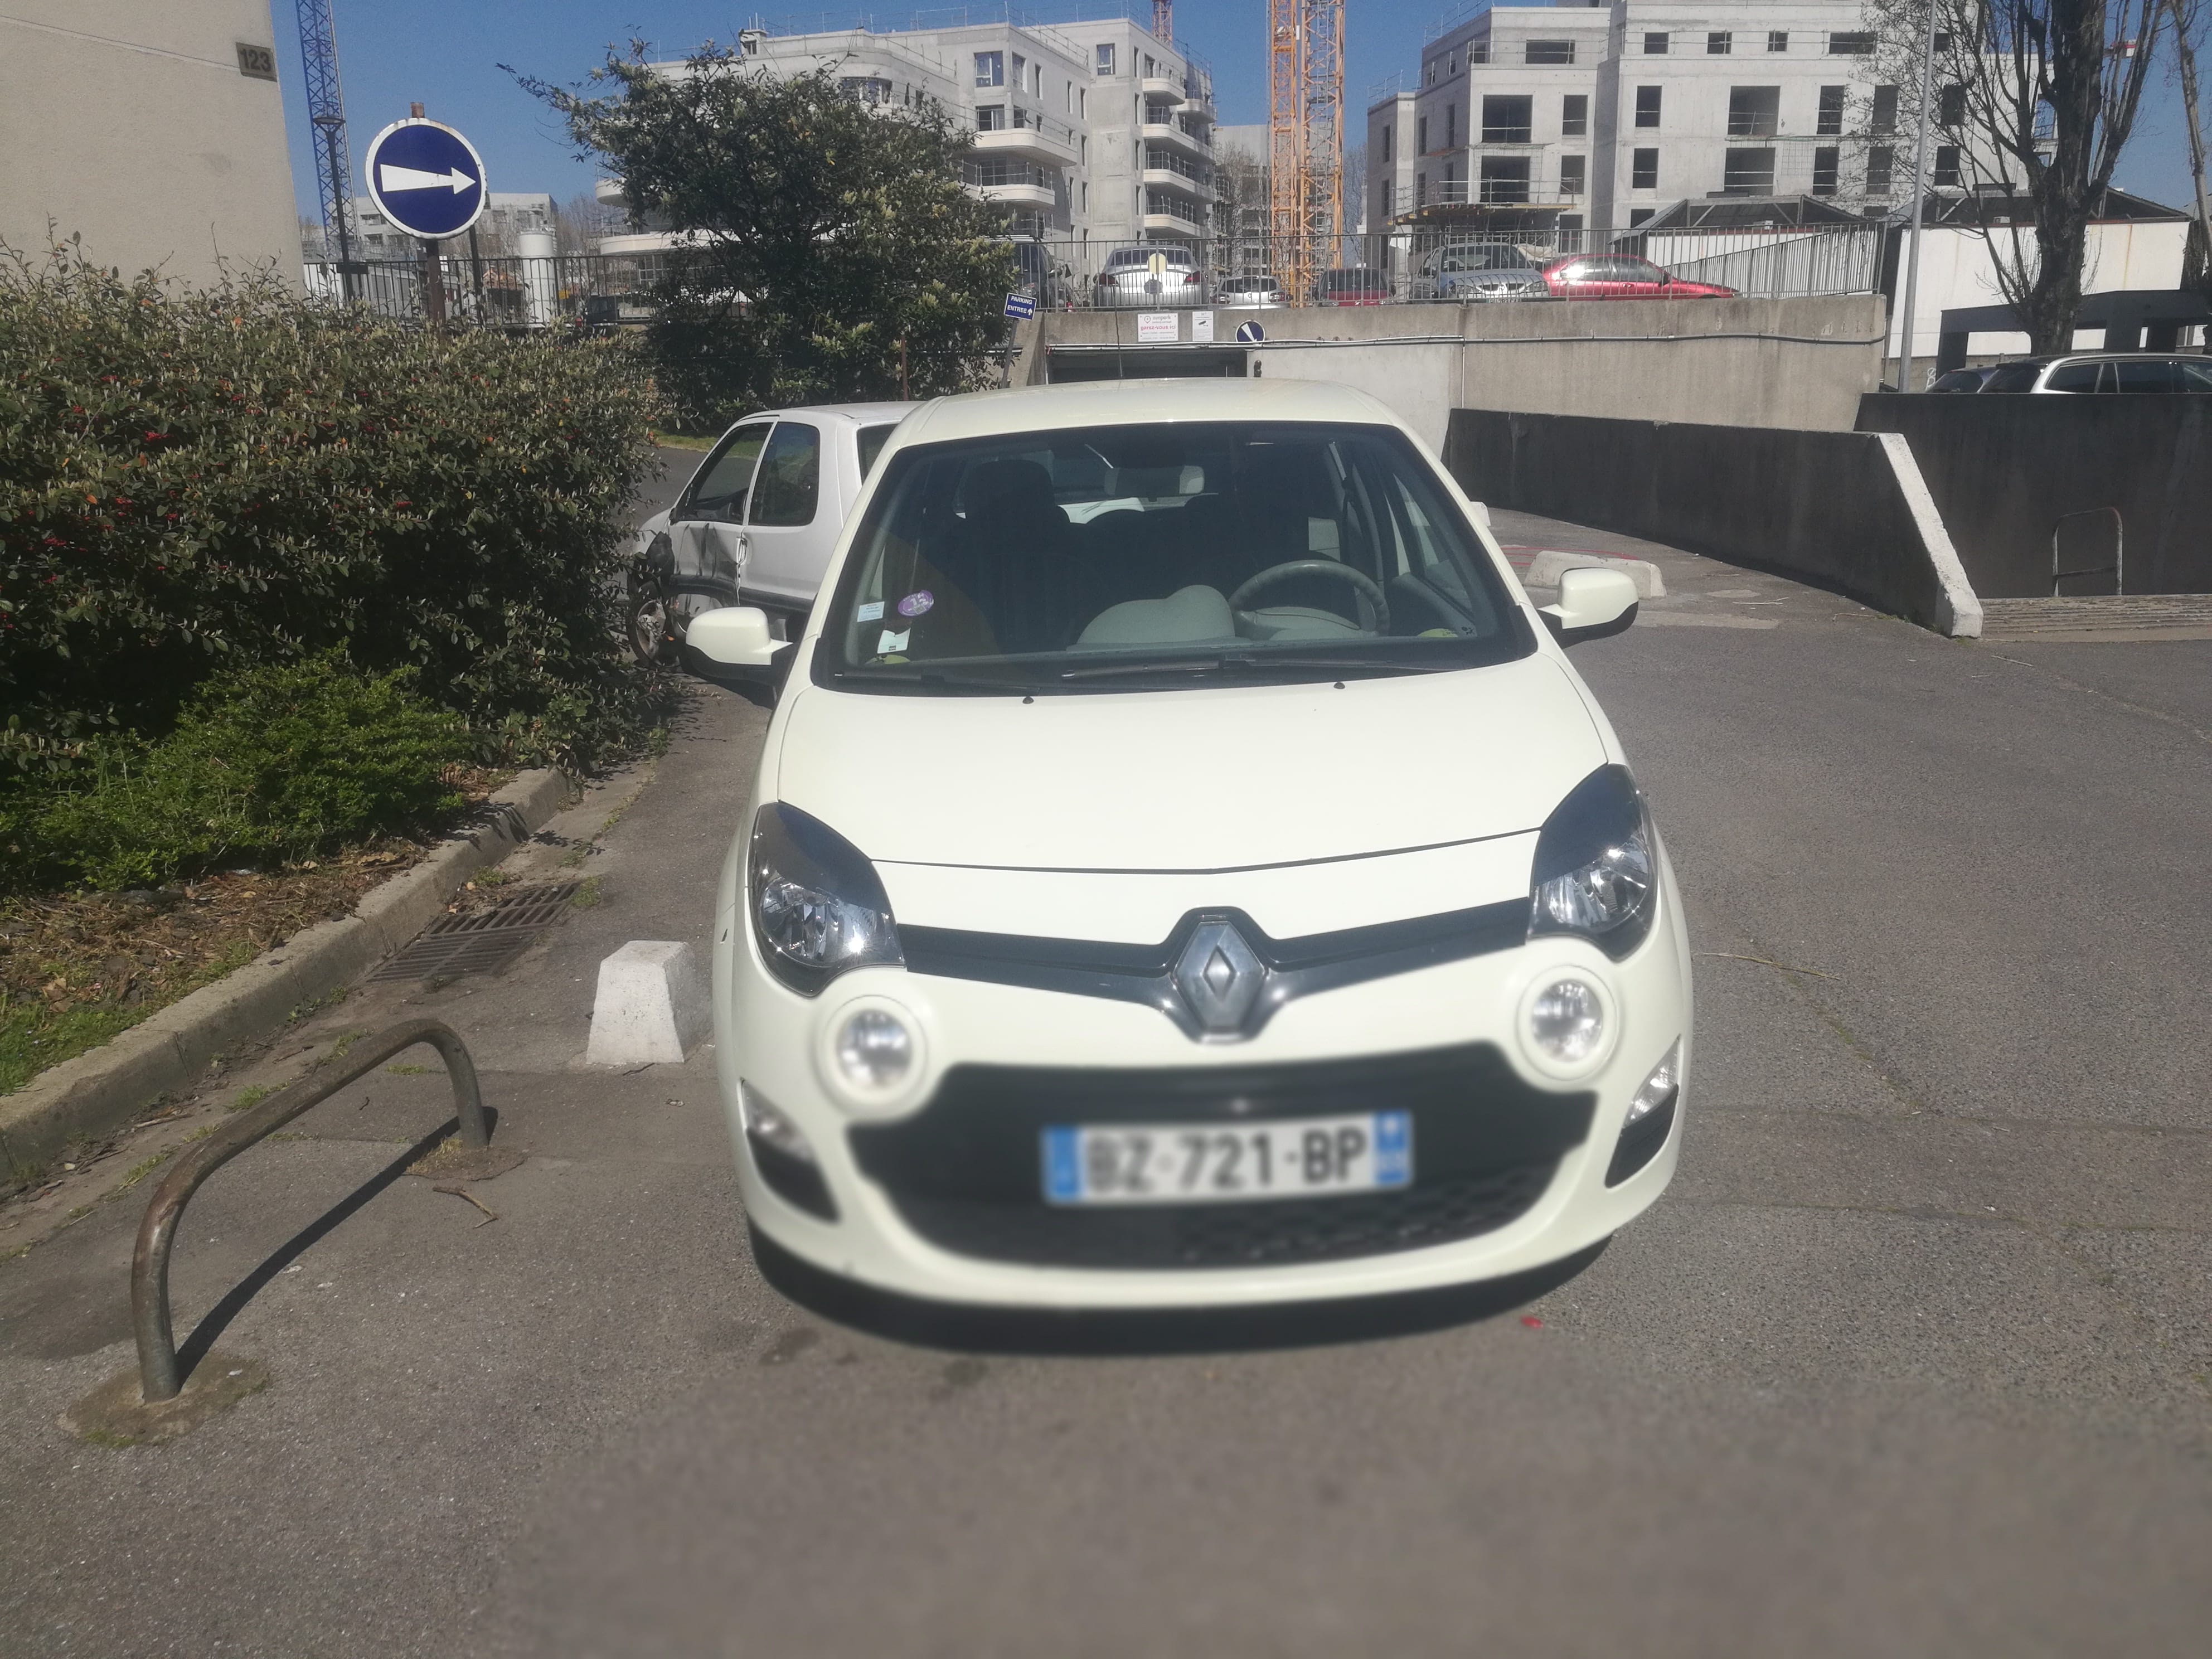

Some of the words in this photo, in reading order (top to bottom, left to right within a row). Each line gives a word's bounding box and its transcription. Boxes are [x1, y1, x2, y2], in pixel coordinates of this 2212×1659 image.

[240, 48, 271, 72] 123
[1011, 295, 1032, 304] PARKING
[1007, 304, 1027, 313] ENTREE
